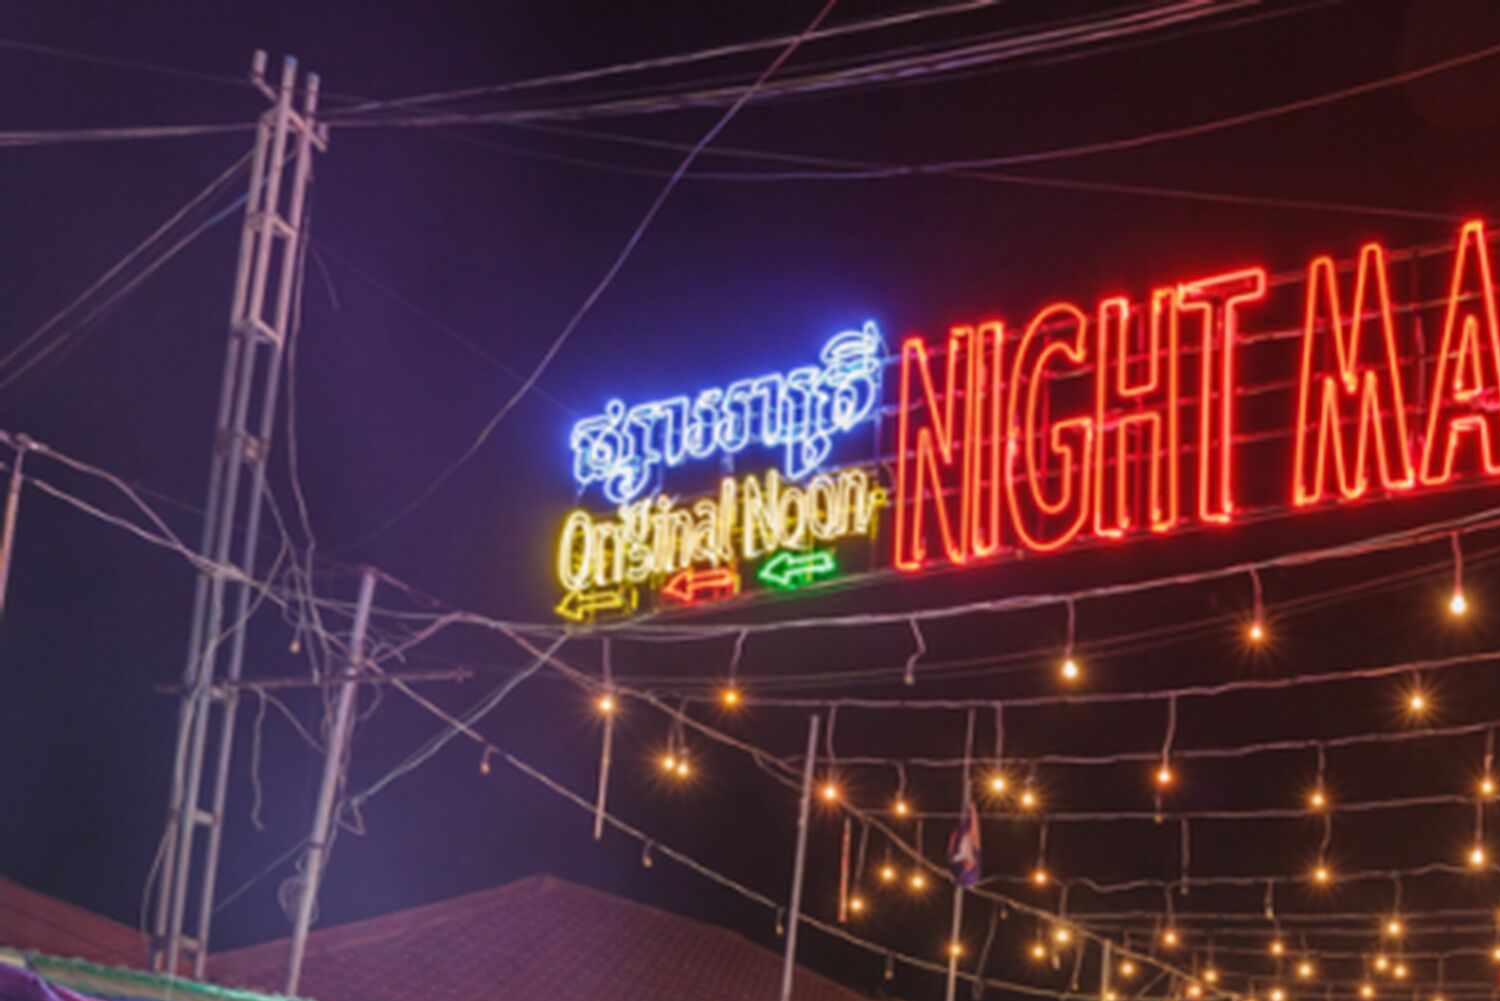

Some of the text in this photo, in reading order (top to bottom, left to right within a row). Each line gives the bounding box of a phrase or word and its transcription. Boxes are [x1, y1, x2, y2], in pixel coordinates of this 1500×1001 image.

[896, 268, 1265, 571] NIGHT
[557, 469, 870, 591] Original Noon
